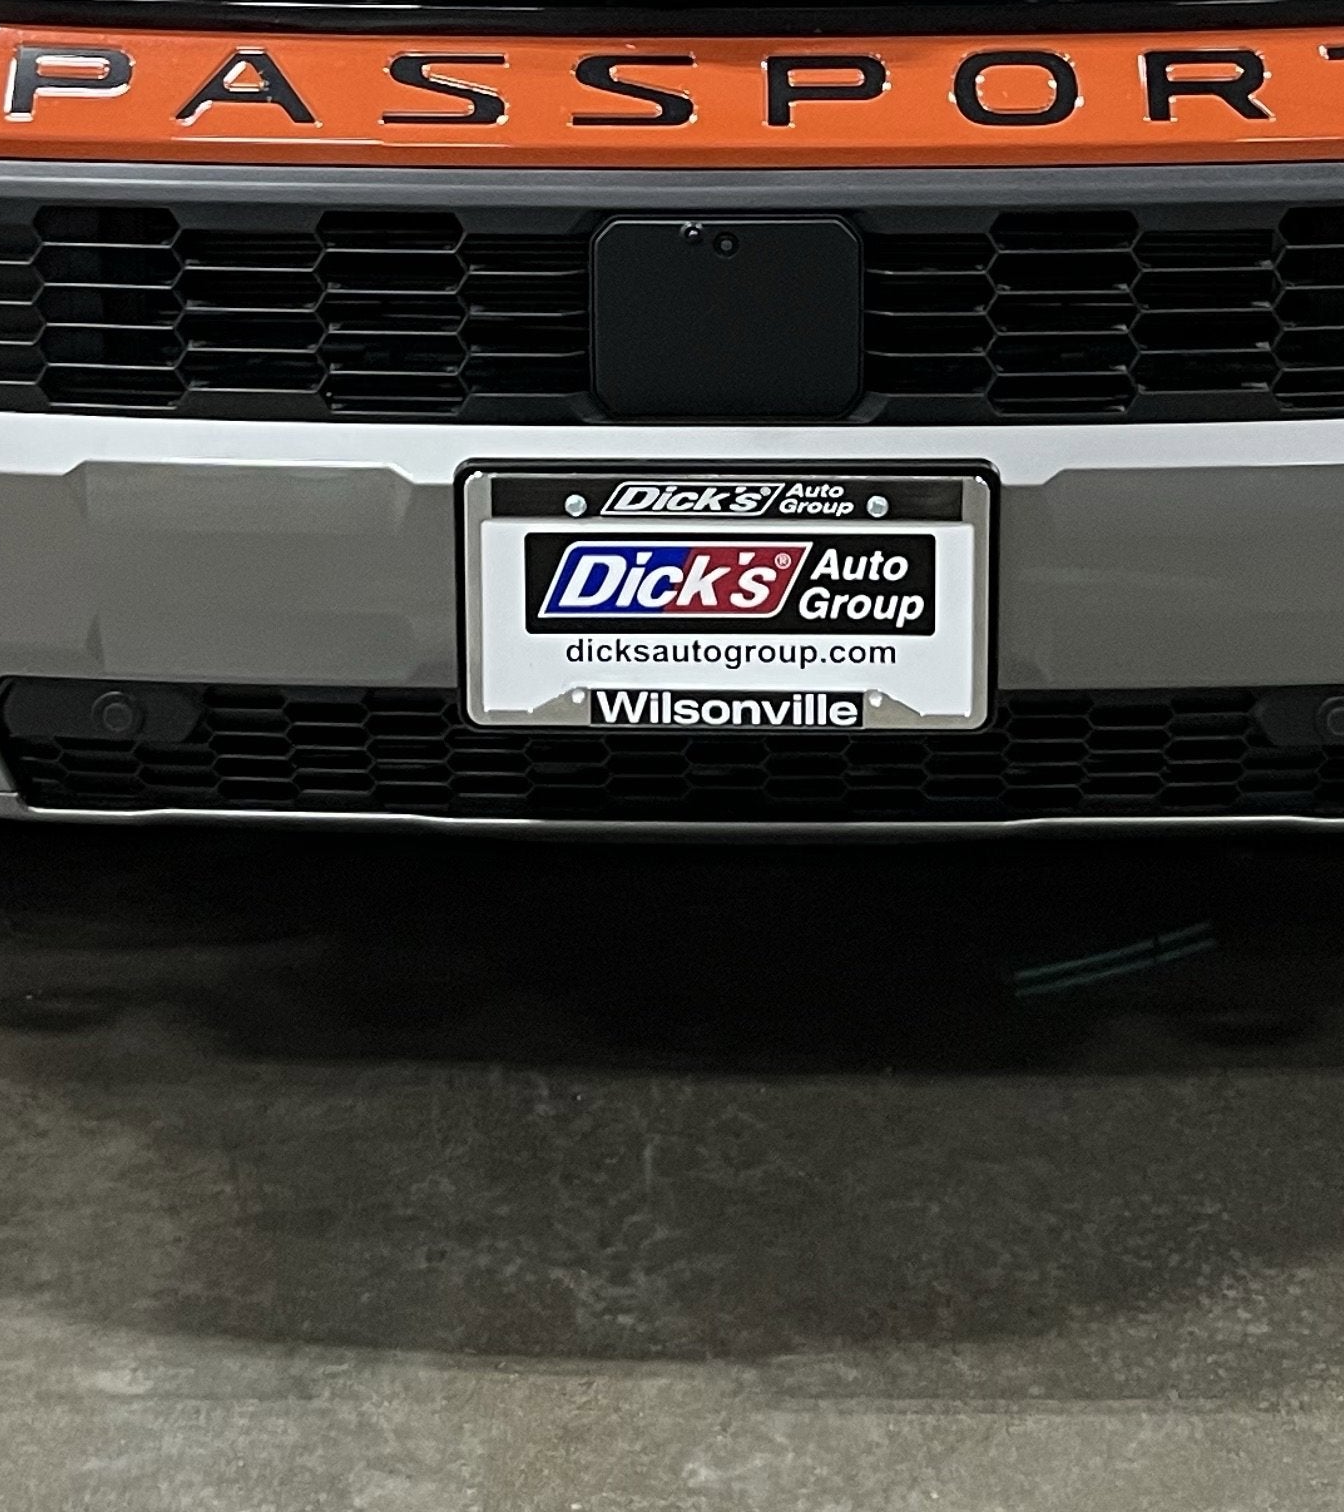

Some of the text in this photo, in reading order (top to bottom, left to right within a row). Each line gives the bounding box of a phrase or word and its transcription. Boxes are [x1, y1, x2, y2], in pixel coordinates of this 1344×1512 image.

[785, 483, 845, 498] Auto
[778, 498, 855, 517] Group
[810, 548, 909, 582] Auto
[798, 587, 926, 629] Group
[565, 639, 898, 670] dicksautogroup.com
[596, 691, 859, 727] Wilsonville
